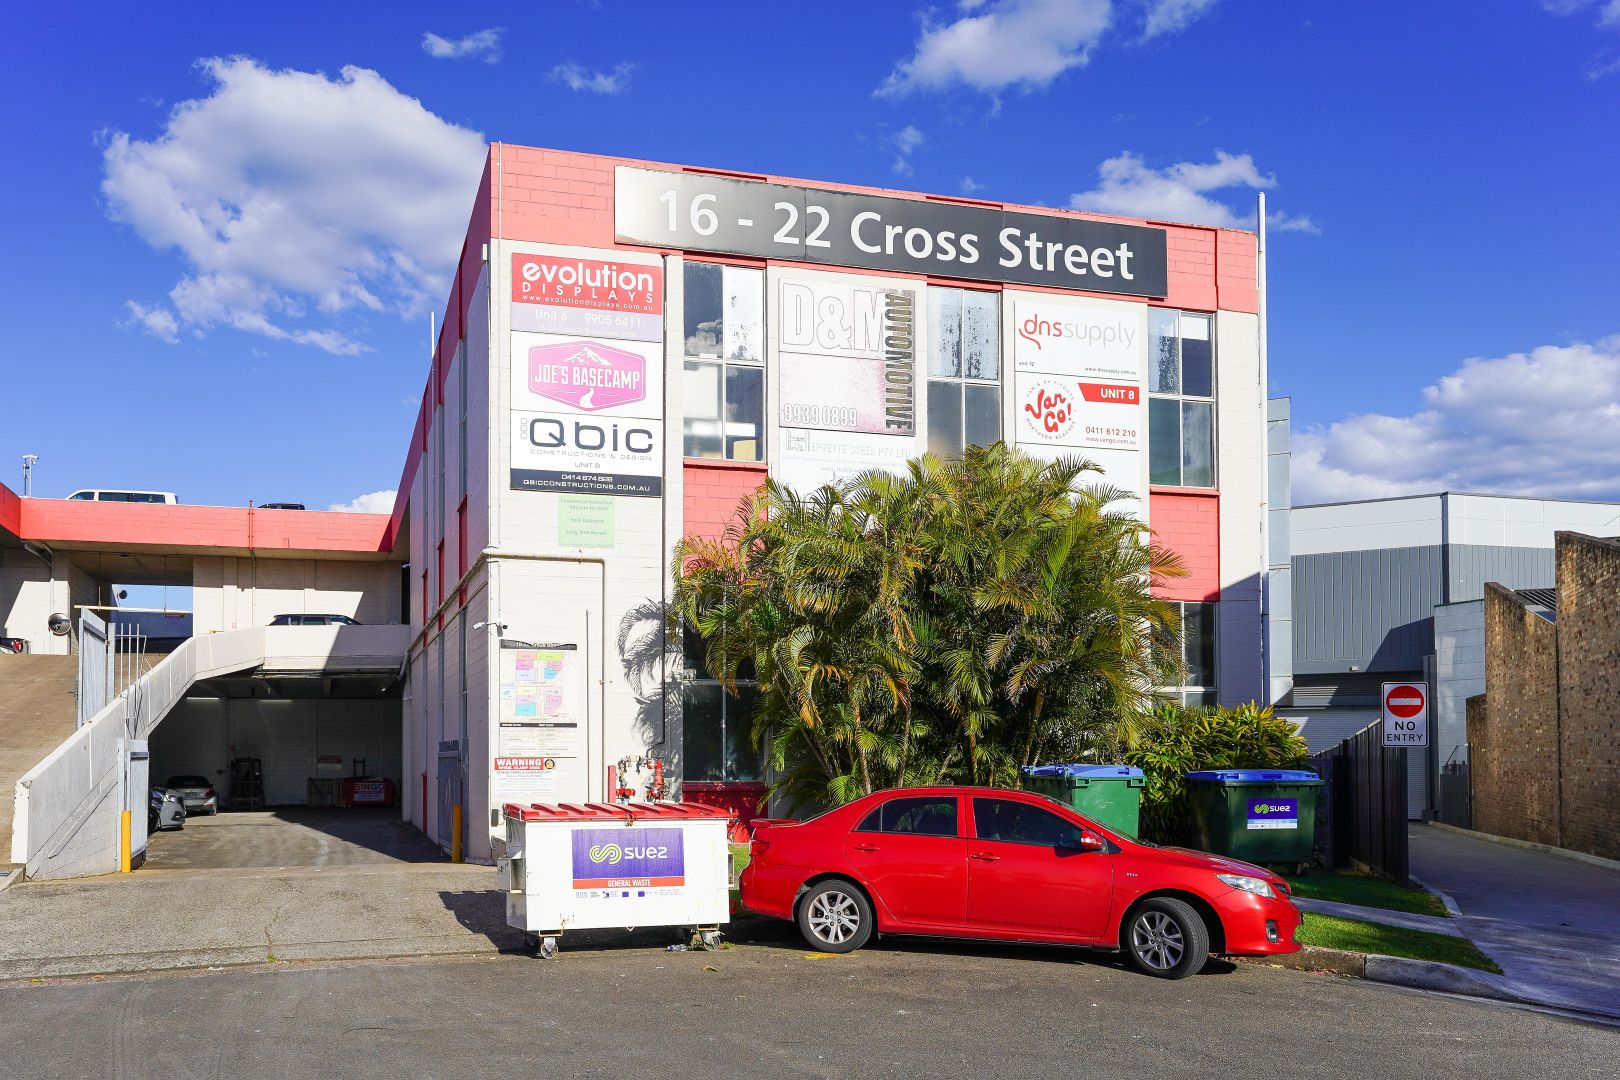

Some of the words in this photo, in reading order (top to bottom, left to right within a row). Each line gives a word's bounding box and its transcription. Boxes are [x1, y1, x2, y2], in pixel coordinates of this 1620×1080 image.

[658, 189, 719, 236] 16
[738, 218, 753, 227] -
[773, 201, 831, 249] 22
[850, 211, 980, 264] Cross
[998, 227, 1134, 280] Street
[522, 262, 653, 291] evolution
[522, 282, 653, 303] DISPLAYS
[522, 294, 653, 311] www.evolutiondisplays.com.au
[535, 308, 558, 321] Unit
[560, 312, 567, 322] 6
[585, 313, 612, 326] 9905
[615, 316, 641, 329] 6411
[783, 283, 884, 353] D&M
[884, 293, 913, 429] AUTOMOTIVE
[535, 363, 569, 385] JOE'S
[572, 366, 640, 389] BASECAMP
[1024, 388, 1067, 420] Van
[1100, 388, 1126, 399] UNIT
[1128, 390, 1135, 400] 8
[783, 402, 820, 426] 9939
[821, 405, 857, 427] 0899
[1044, 403, 1072, 432] Go!
[529, 418, 653, 453] Qbic
[1026, 417, 1053, 440] NORTHERN
[1085, 426, 1103, 435] 0411
[1106, 427, 1120, 436] 612
[1122, 429, 1137, 437] 210
[530, 449, 606, 459] CONSTRUCTIONS
[1395, 721, 1416, 731] NO
[1386, 734, 1424, 742] ENTRY
[496, 758, 542, 766] WARNING
[352, 783, 385, 791] BINGO
[624, 846, 668, 860] suez
[607, 879, 631, 888] GENERAL
[632, 879, 651, 887] WASTE
